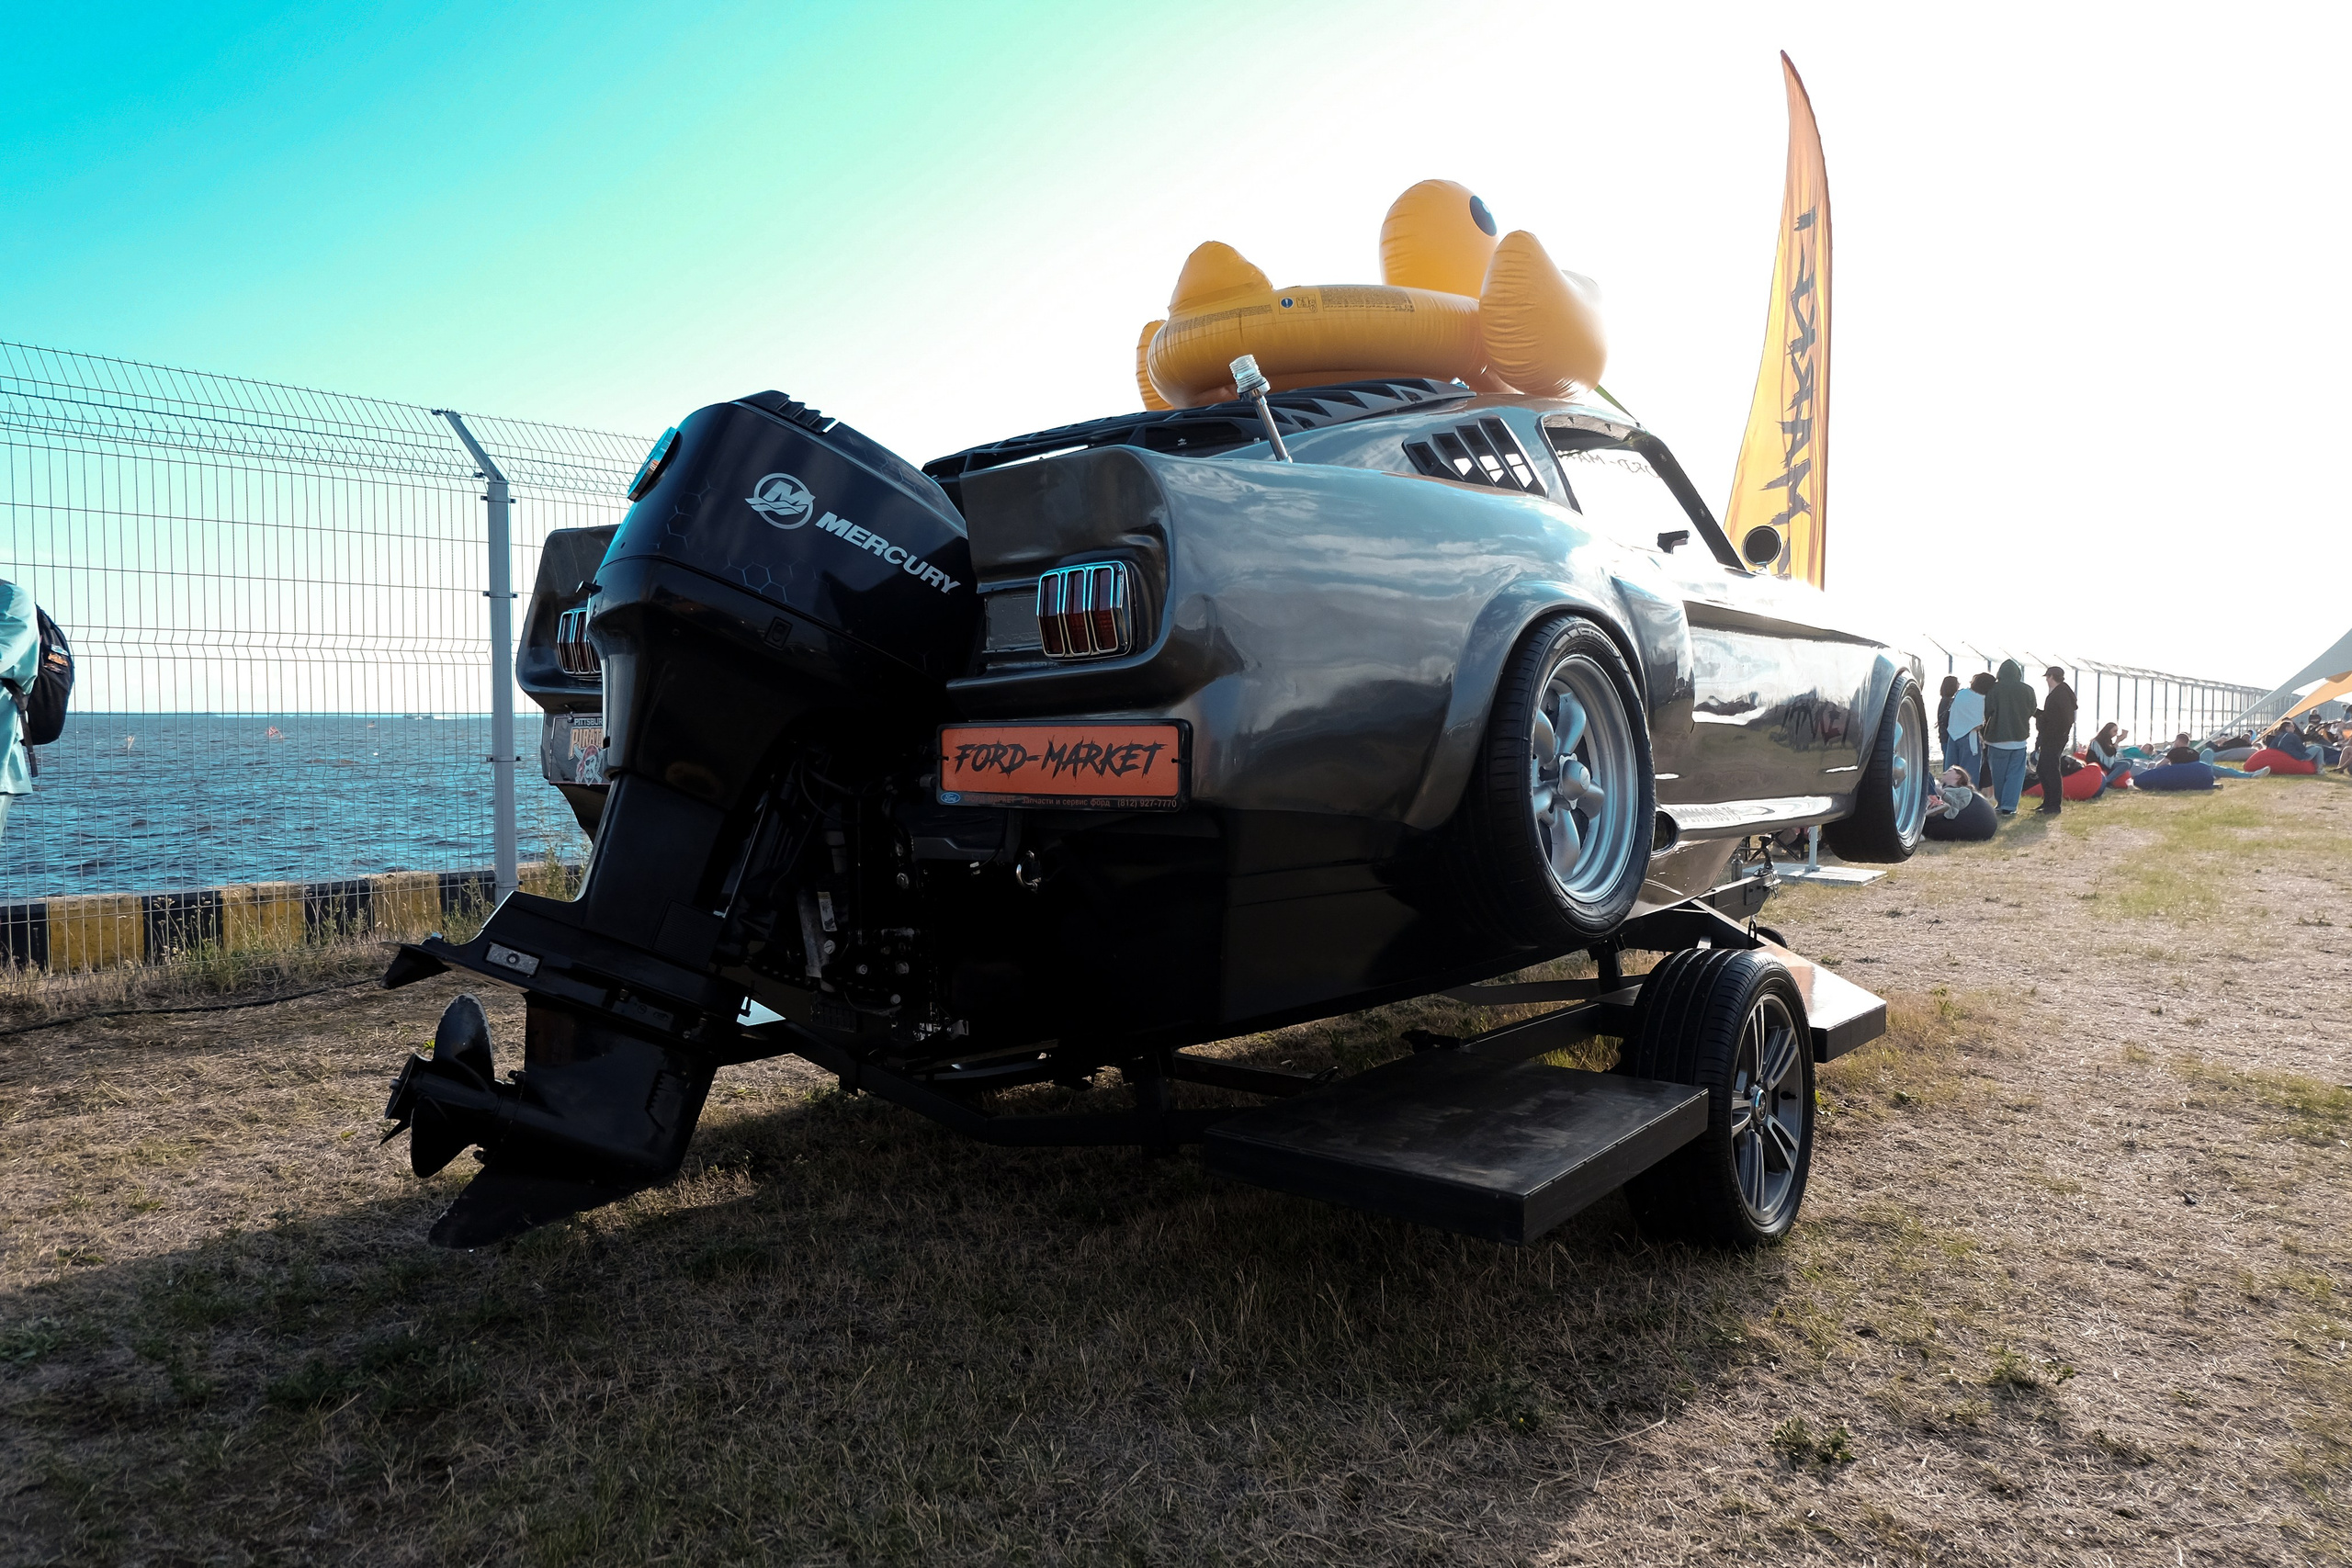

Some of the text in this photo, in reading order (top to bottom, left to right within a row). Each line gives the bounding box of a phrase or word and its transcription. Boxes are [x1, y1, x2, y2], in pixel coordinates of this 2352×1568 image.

[815, 511, 961, 594] MERCURY
[574, 718, 604, 727] PITTSBUR
[954, 735, 1168, 780] FORD-MARKET
[1117, 799, 1137, 808] (812)
[1139, 799, 1177, 808] 927-7770
